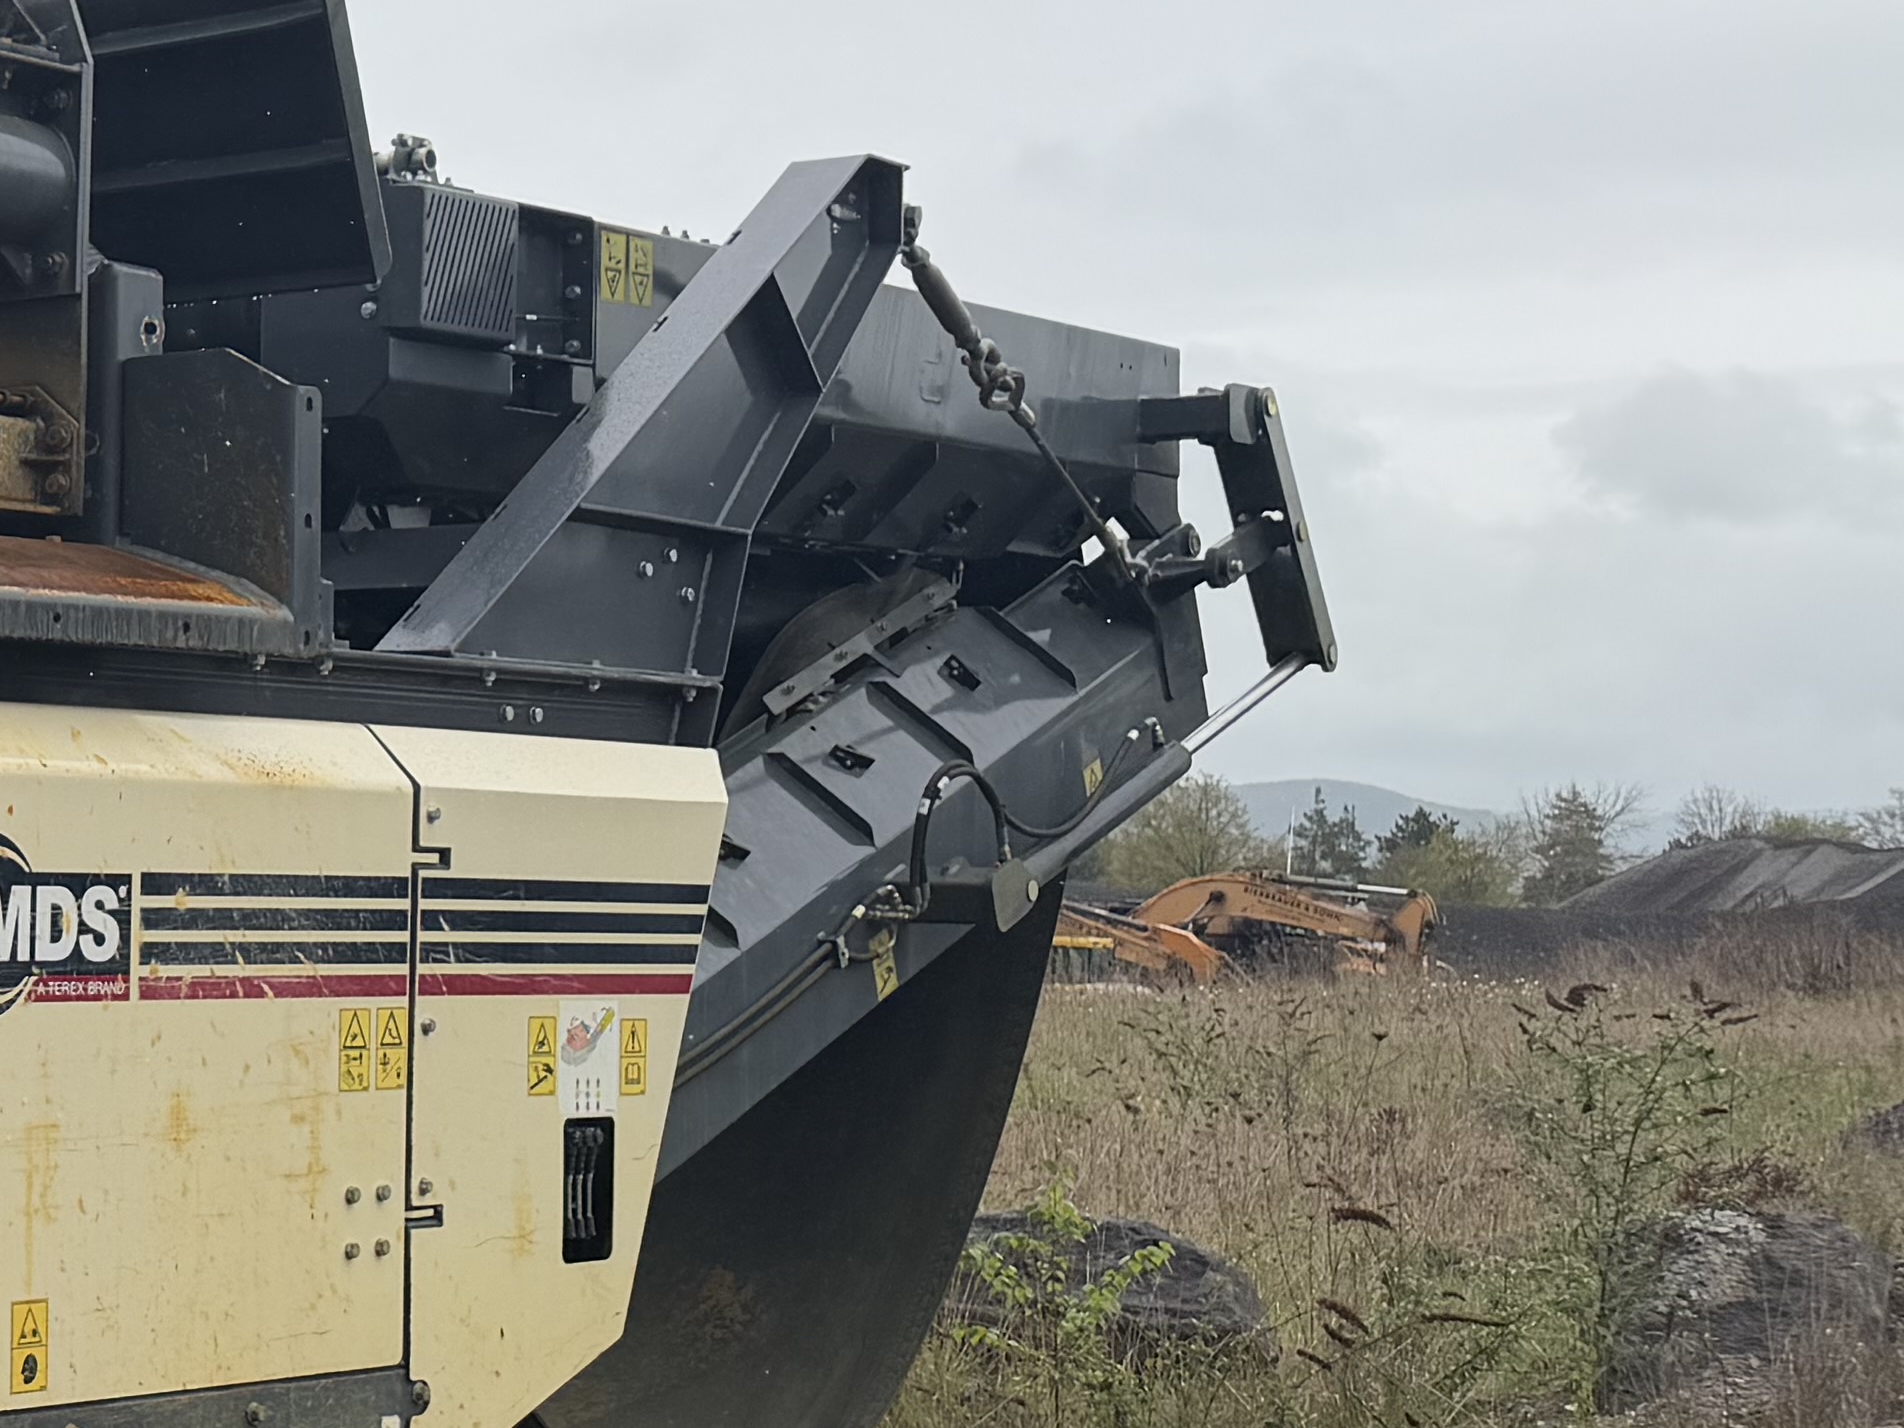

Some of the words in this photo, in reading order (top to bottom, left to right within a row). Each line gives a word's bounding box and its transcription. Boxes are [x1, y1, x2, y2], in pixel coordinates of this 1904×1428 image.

[36, 981, 46, 996] A
[48, 981, 85, 996] TEREX
[87, 980, 125, 996] BRAND
